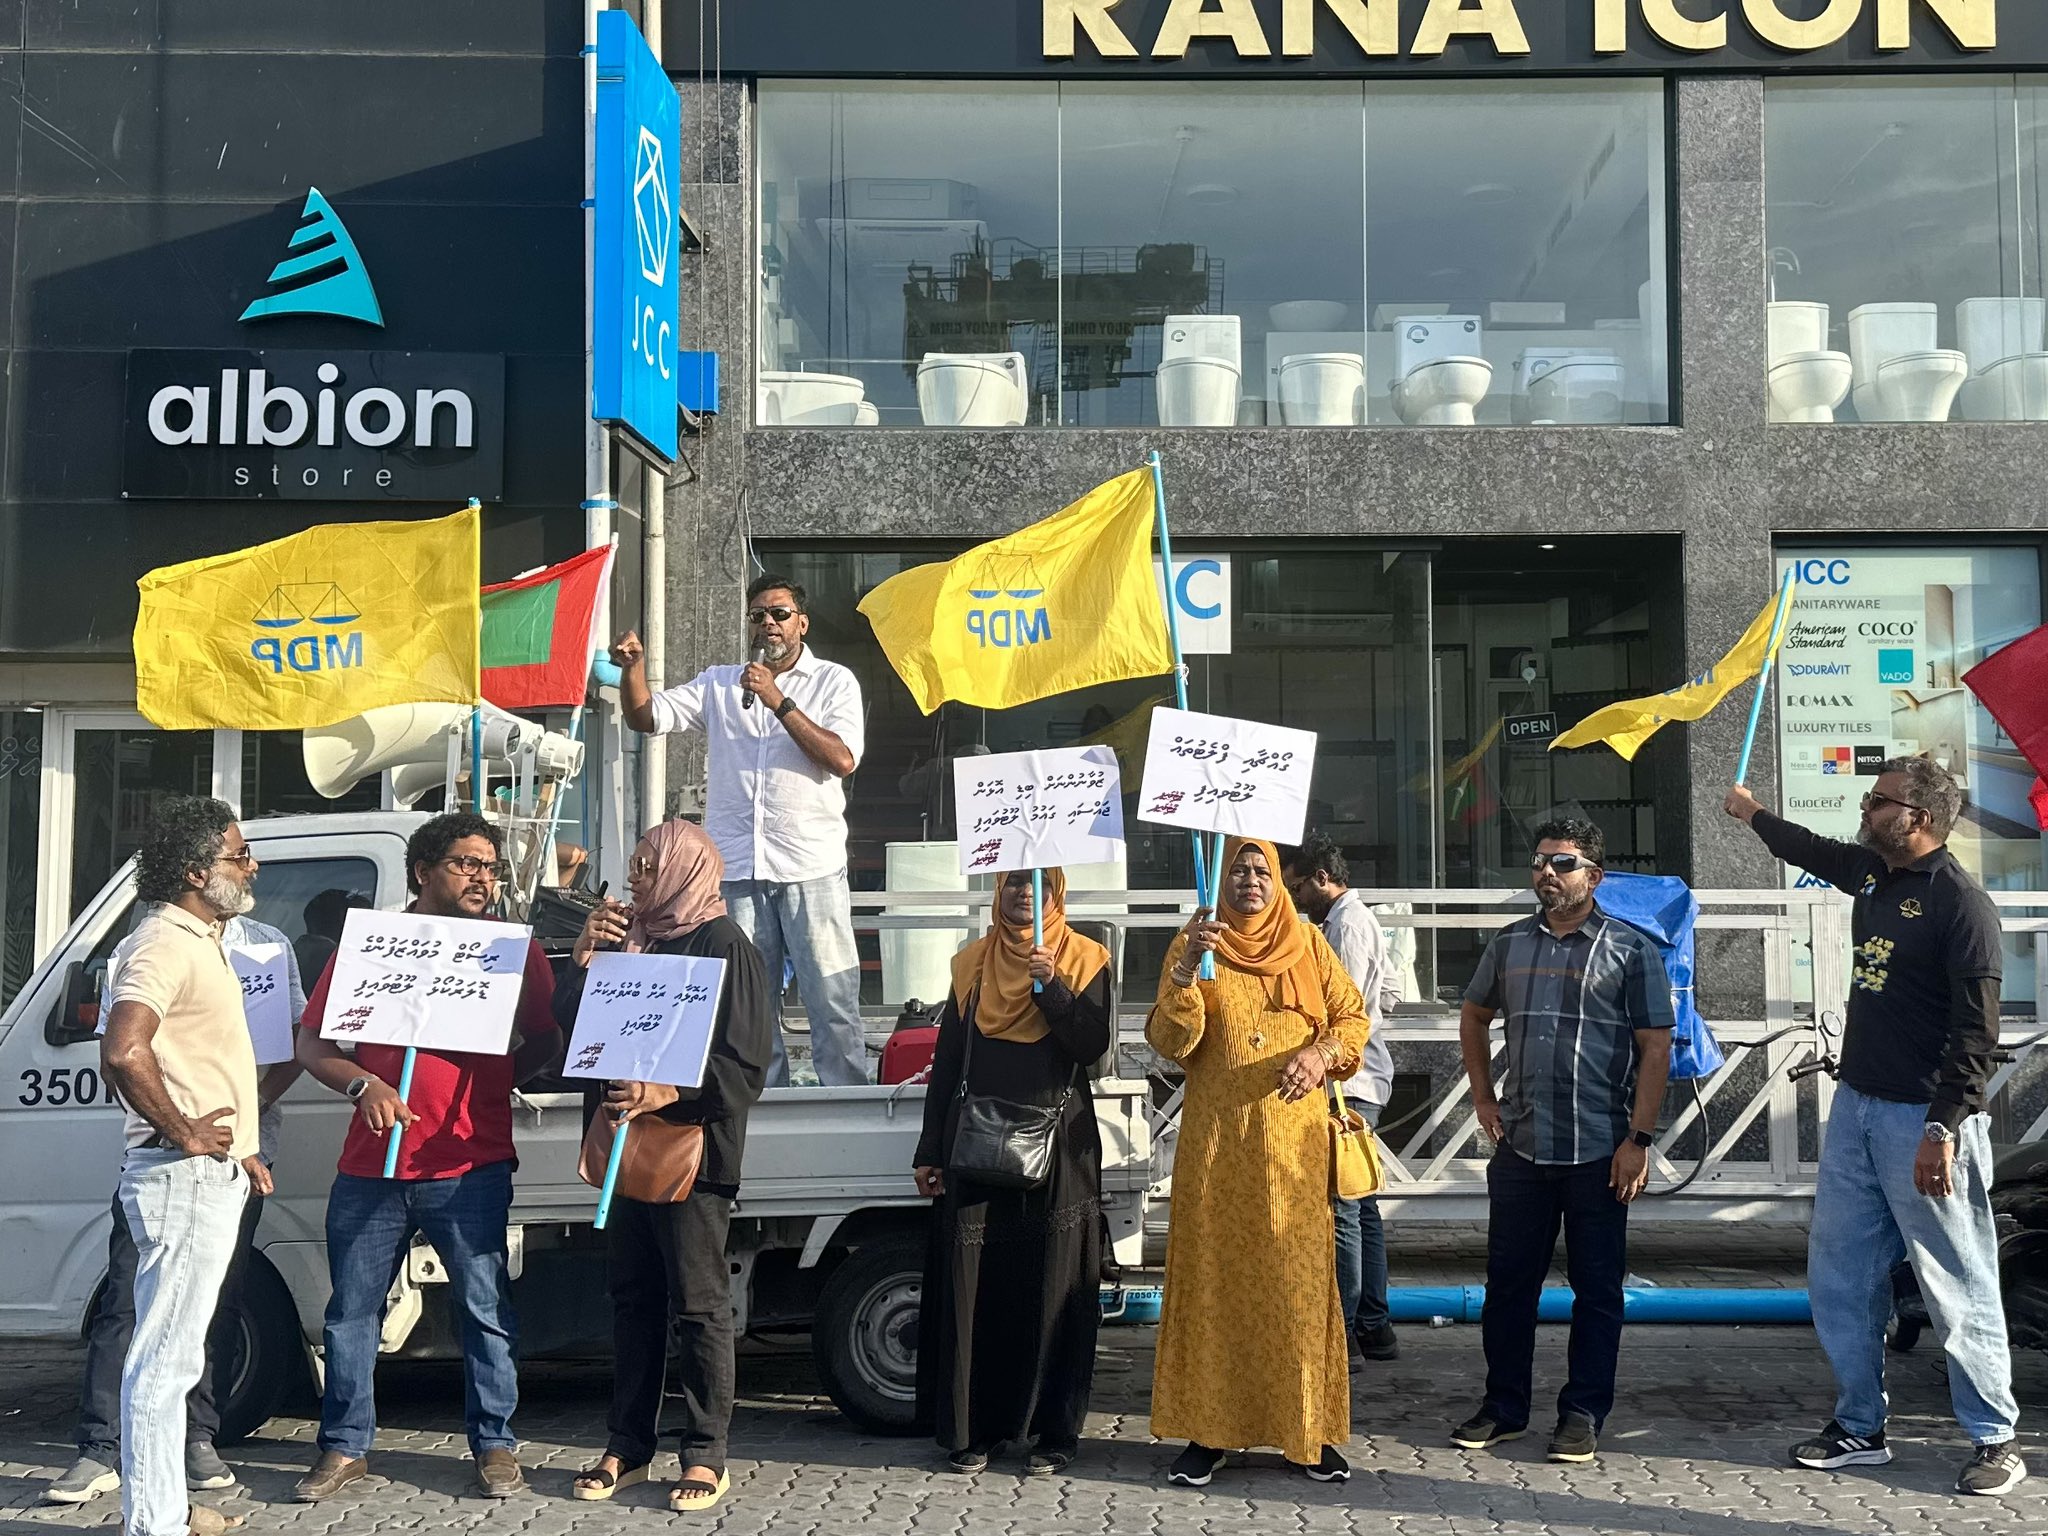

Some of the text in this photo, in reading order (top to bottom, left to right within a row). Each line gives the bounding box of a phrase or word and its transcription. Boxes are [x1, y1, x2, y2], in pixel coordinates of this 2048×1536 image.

[632, 294, 670, 380] JCC
[147, 362, 474, 447] albion
[234, 463, 392, 488] store
[1795, 559, 1850, 585] JCC
[1792, 599, 1881, 609] ANITARYWARE
[1789, 620, 1847, 636] American
[1786, 635, 1847, 649] Standard
[1805, 662, 1851, 676] DURAVIT
[1881, 672, 1912, 681] VADO
[1787, 695, 1853, 707] ROMAX
[1510, 719, 1550, 735] OPEN
[1787, 723, 1872, 733] LUXURY TILES
[1789, 796, 1842, 808] Guocera
